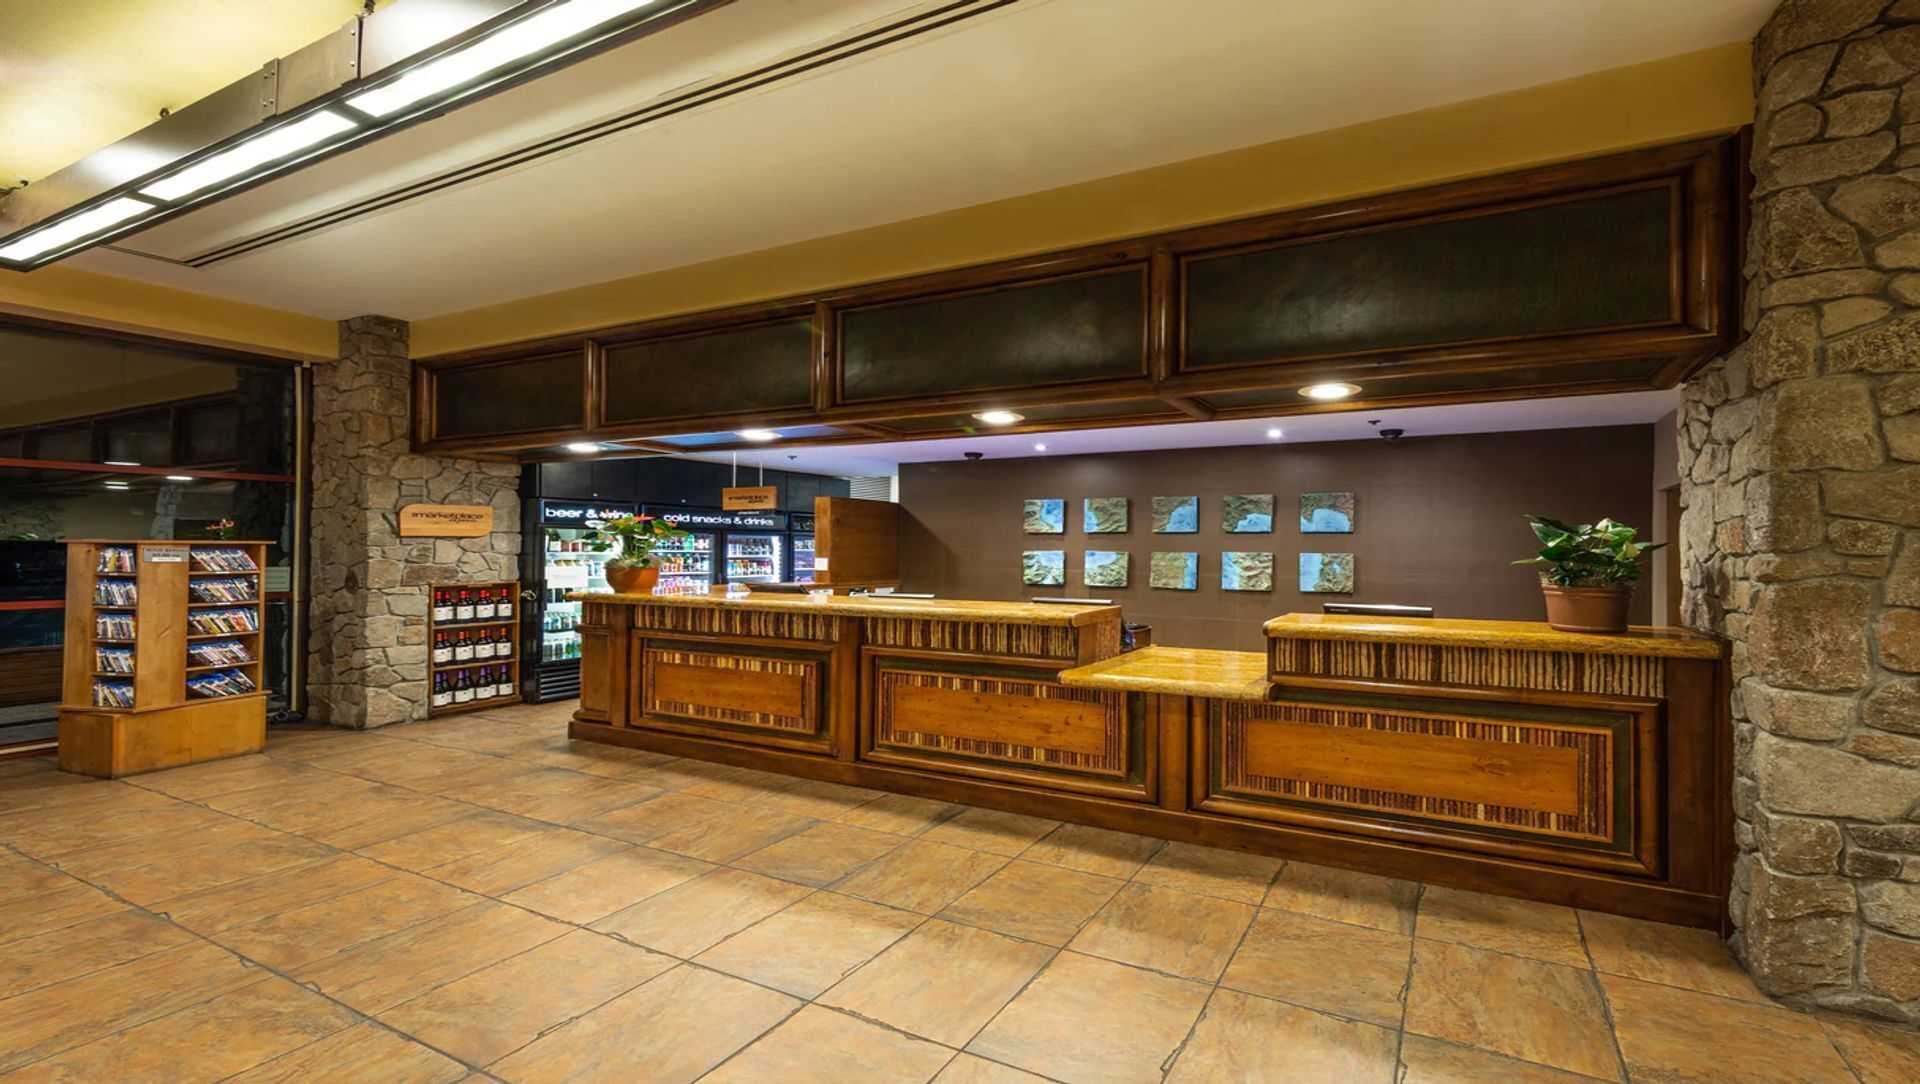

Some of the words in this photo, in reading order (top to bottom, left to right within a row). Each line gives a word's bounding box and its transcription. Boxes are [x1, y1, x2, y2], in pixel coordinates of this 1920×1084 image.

[545, 507, 583, 518] beer
[586, 508, 598, 519] &
[663, 514, 690, 523] cold
[692, 515, 732, 525] snacks
[734, 516, 743, 525] &
[744, 517, 775, 526] drinks
